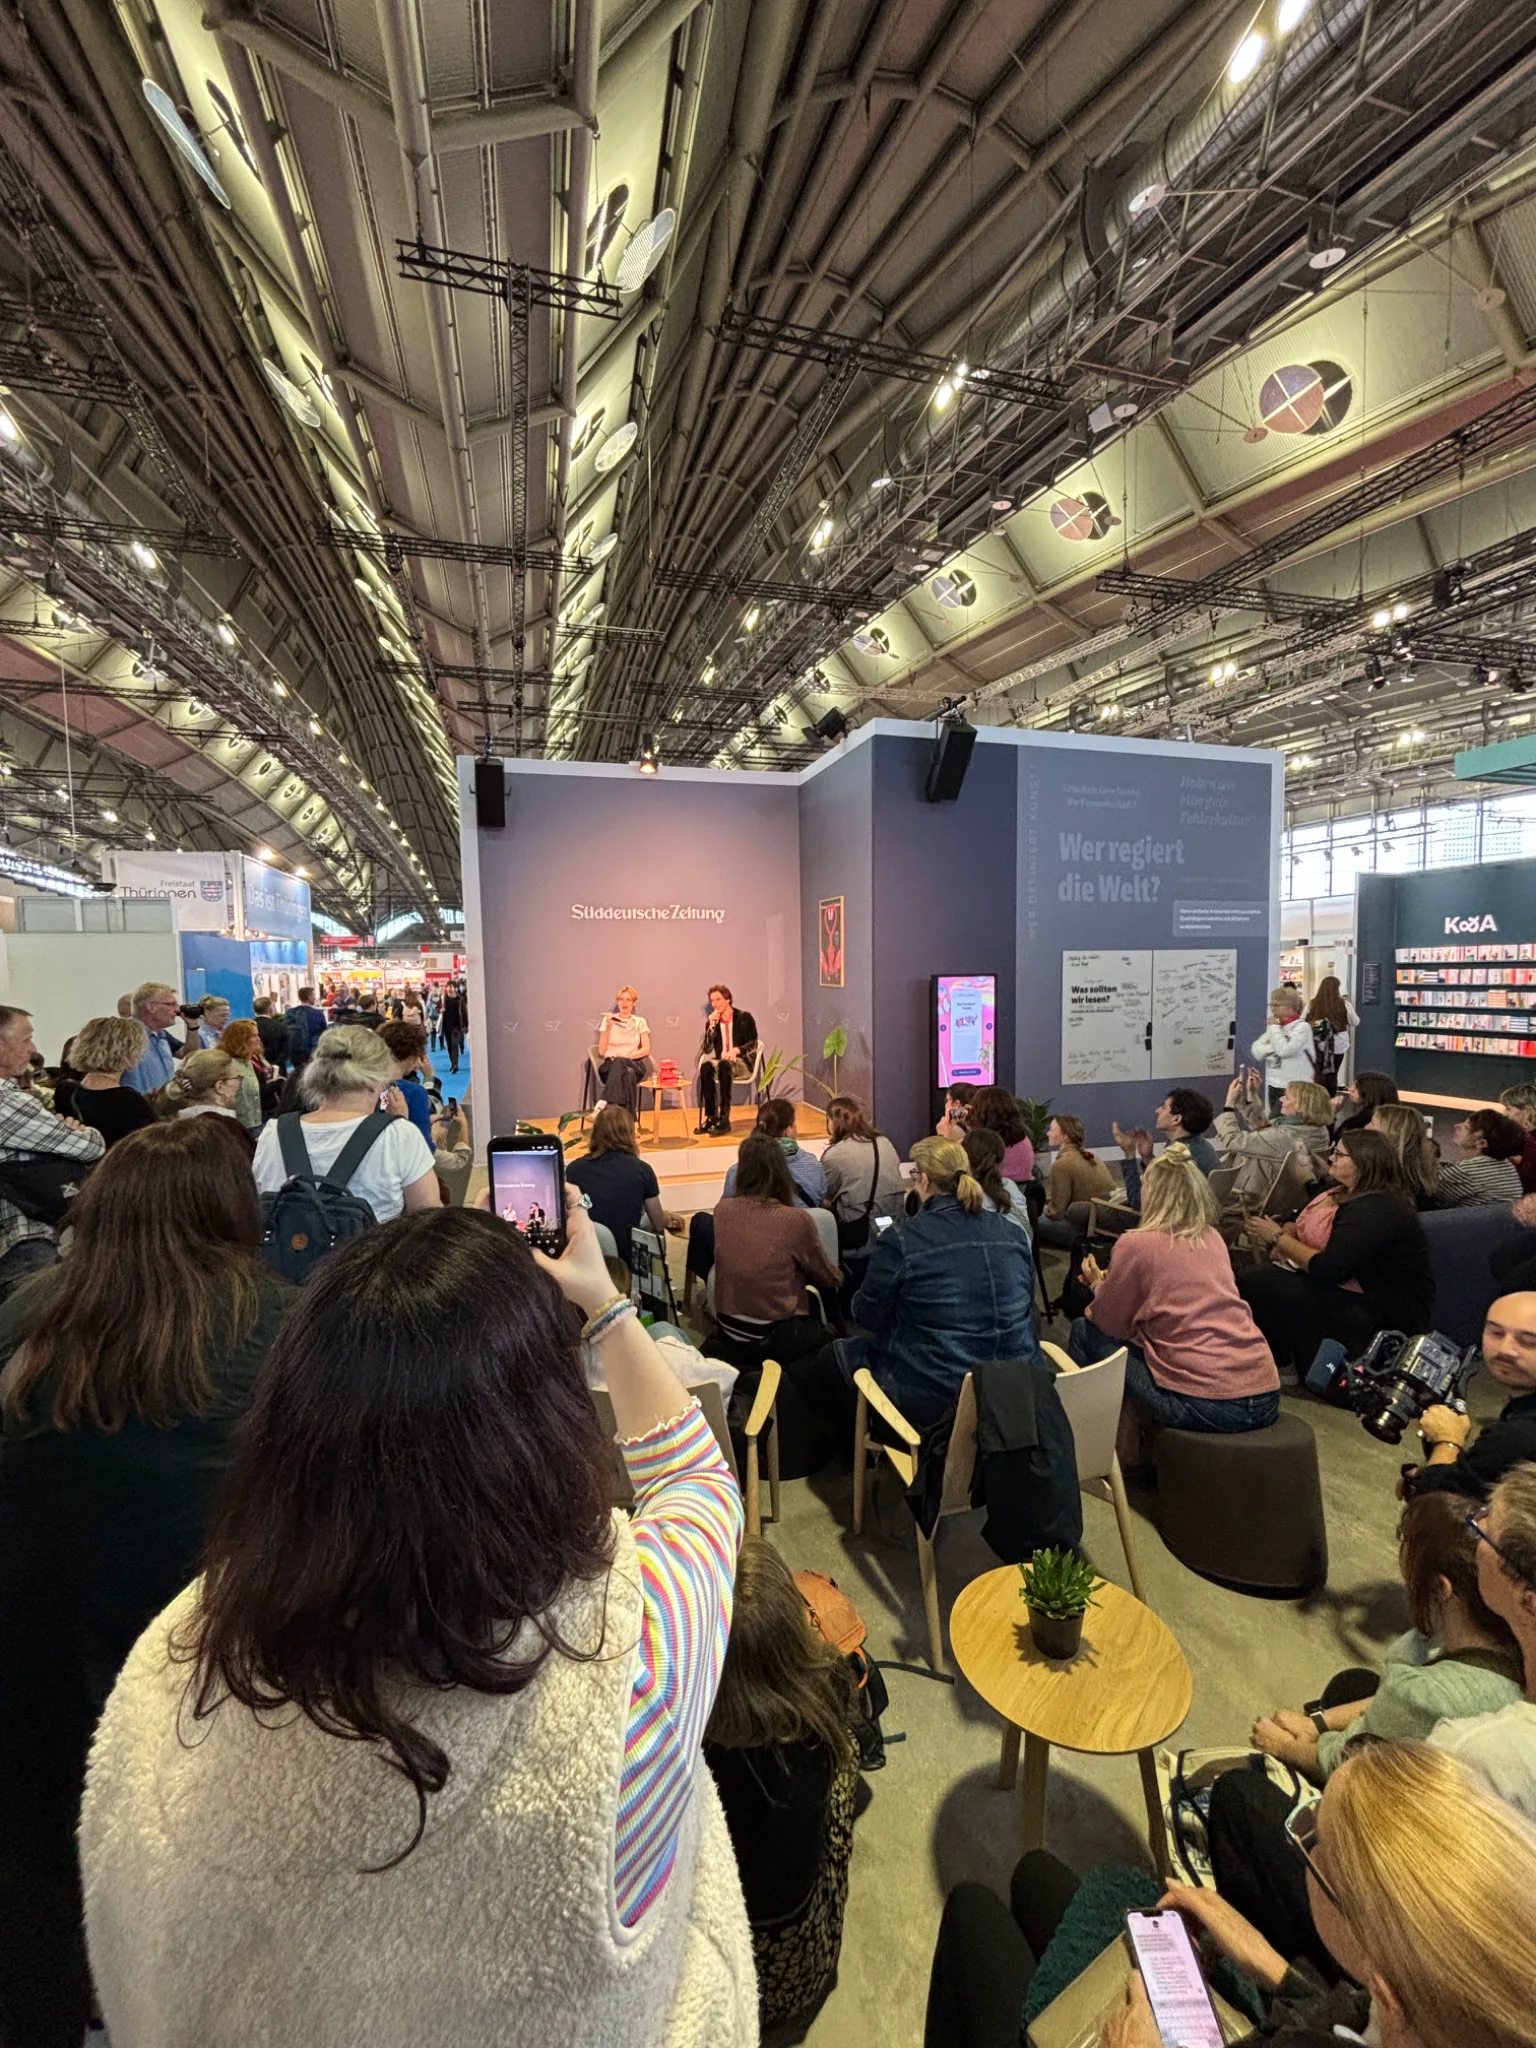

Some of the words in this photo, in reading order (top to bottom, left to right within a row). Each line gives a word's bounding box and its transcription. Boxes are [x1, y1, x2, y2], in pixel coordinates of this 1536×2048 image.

[1058, 833, 1105, 862] Wer
[1108, 835, 1184, 870] regiert
[160, 879, 195, 888] Freistaat
[1058, 873, 1094, 902] die
[1098, 874, 1160, 903] Welt?
[248, 883, 264, 908] Das
[264, 888, 275, 911] ist
[571, 904, 670, 920] Süddeutsche
[669, 904, 726, 925] Zeitung
[1071, 985, 1088, 994] Was
[1089, 985, 1117, 994] sollten
[1071, 996, 1084, 1004] wir
[1085, 995, 1110, 1004] lesen?
